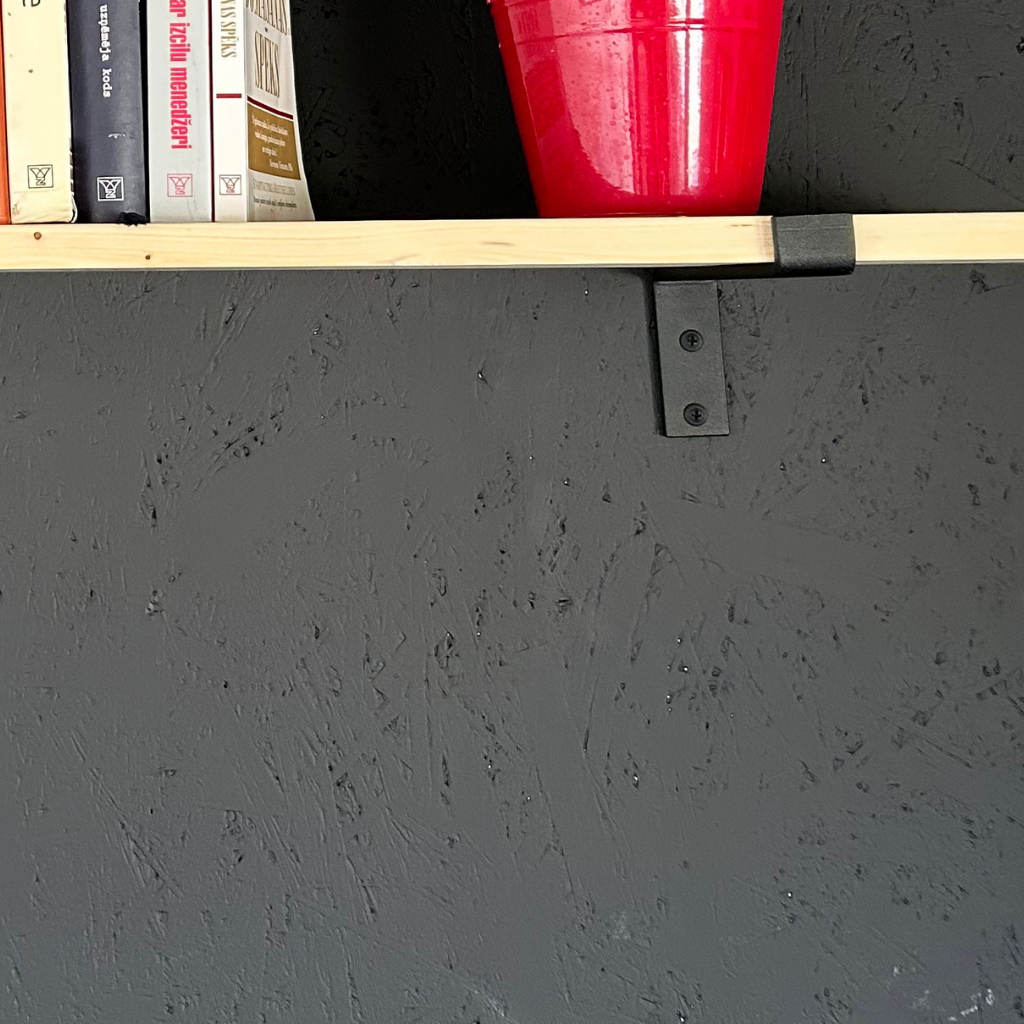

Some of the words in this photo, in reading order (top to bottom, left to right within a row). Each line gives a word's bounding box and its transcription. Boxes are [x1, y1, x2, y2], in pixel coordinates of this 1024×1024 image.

[98, 4, 111, 61] uzņēmēja
[169, 23, 191, 62] izcilu
[220, 21, 239, 58] SPĒKS
[101, 68, 112, 98] kods
[170, 67, 192, 149] menedžeri
